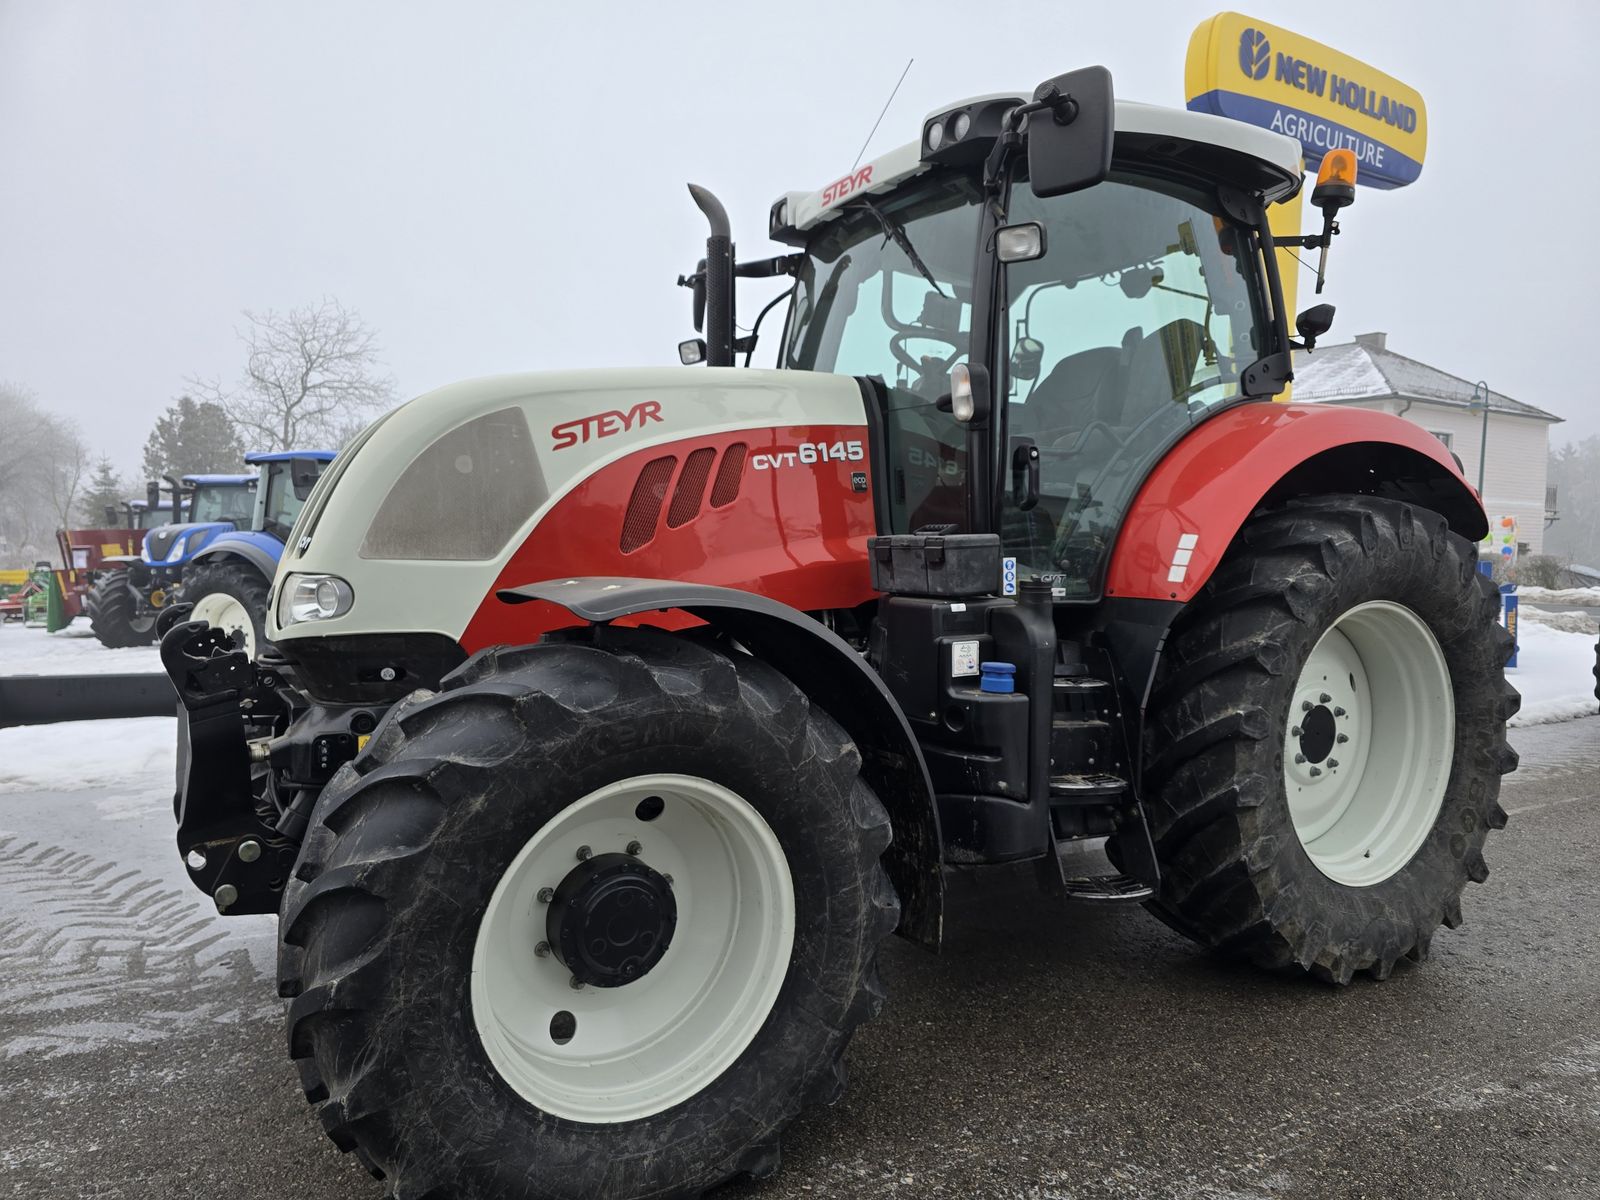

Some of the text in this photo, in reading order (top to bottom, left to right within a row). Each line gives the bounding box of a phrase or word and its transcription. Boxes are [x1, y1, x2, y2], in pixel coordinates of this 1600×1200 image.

[1275, 52, 1417, 134] NEW HOLLAND
[1270, 109, 1385, 168] AGRICULTURE
[822, 165, 873, 207] STEYR
[551, 400, 664, 451] STEYR
[752, 441, 864, 470] CVT 6145
